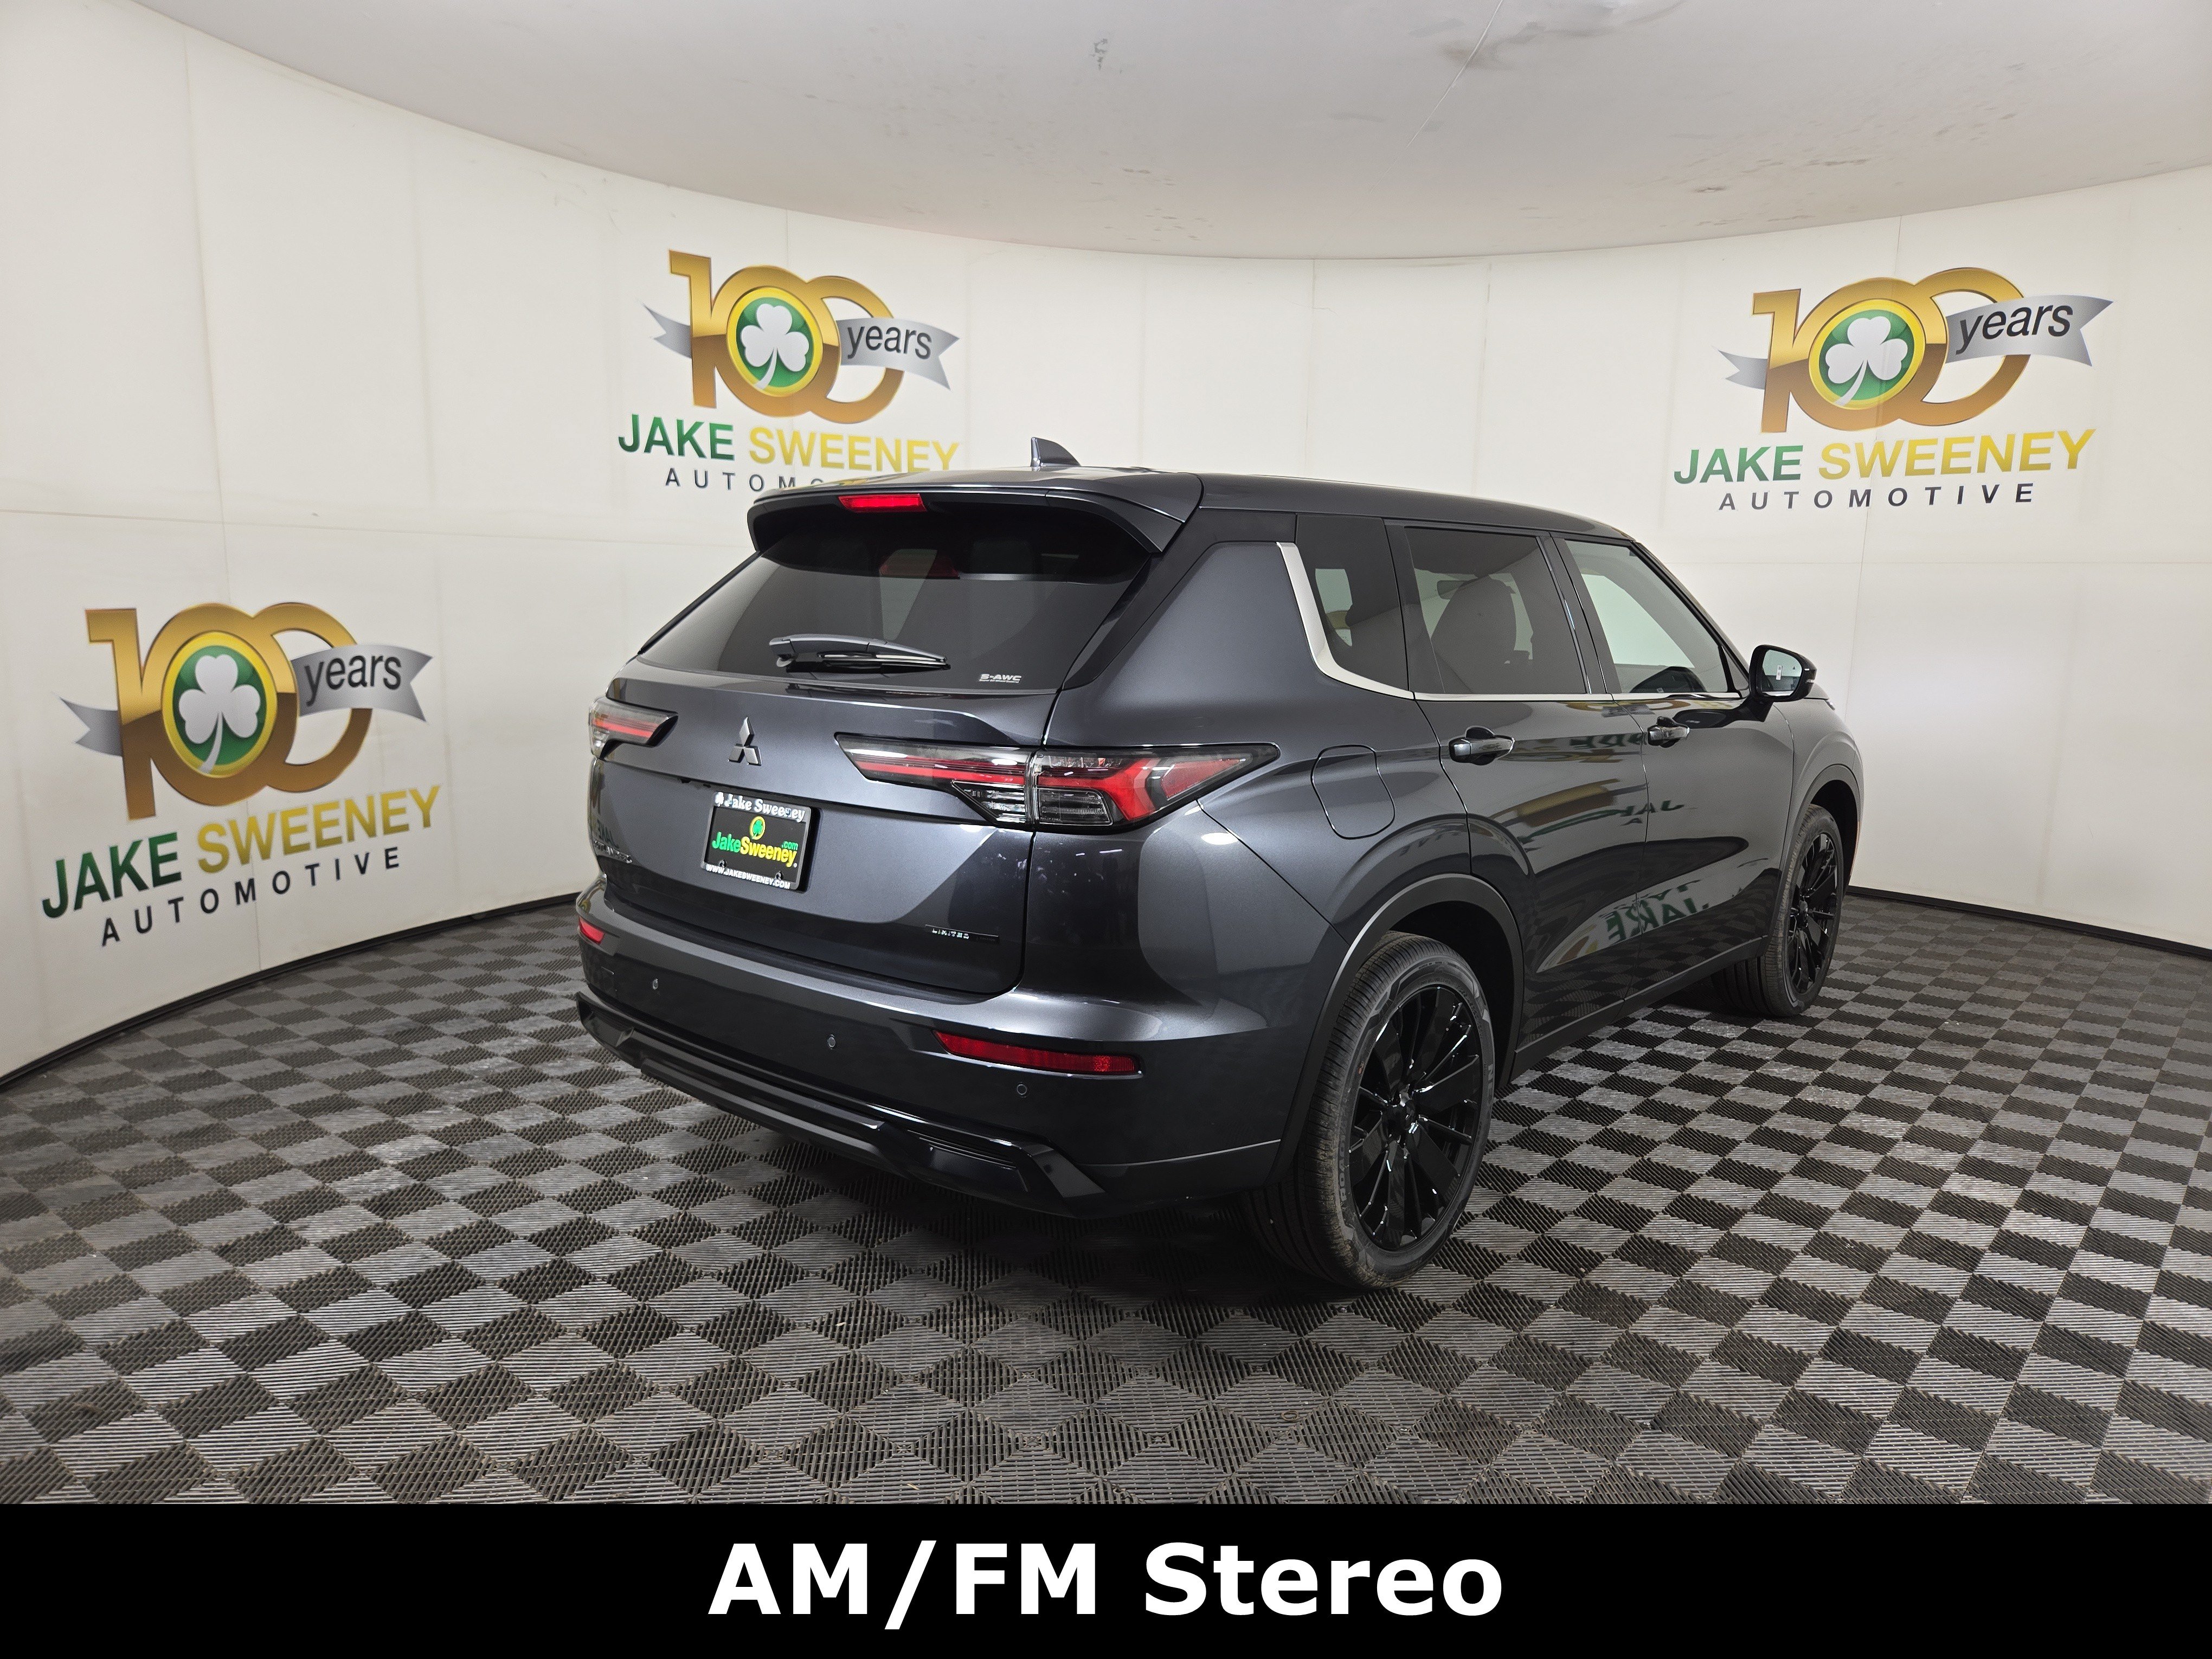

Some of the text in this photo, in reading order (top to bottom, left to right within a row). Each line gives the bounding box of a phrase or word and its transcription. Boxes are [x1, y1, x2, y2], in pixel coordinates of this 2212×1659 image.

[846, 325, 933, 360] years
[1955, 304, 2074, 355] years
[618, 413, 960, 472] JAKE SWEENEY
[1673, 428, 2097, 485] JAKE SWEENEY
[1719, 483, 2035, 511] AUTOMOTIVE
[304, 654, 402, 706] years
[724, 793, 806, 823] Jake Sweeney
[42, 784, 442, 919] JAKE SWEENEY
[101, 846, 400, 947] AUTOMOTIVE
